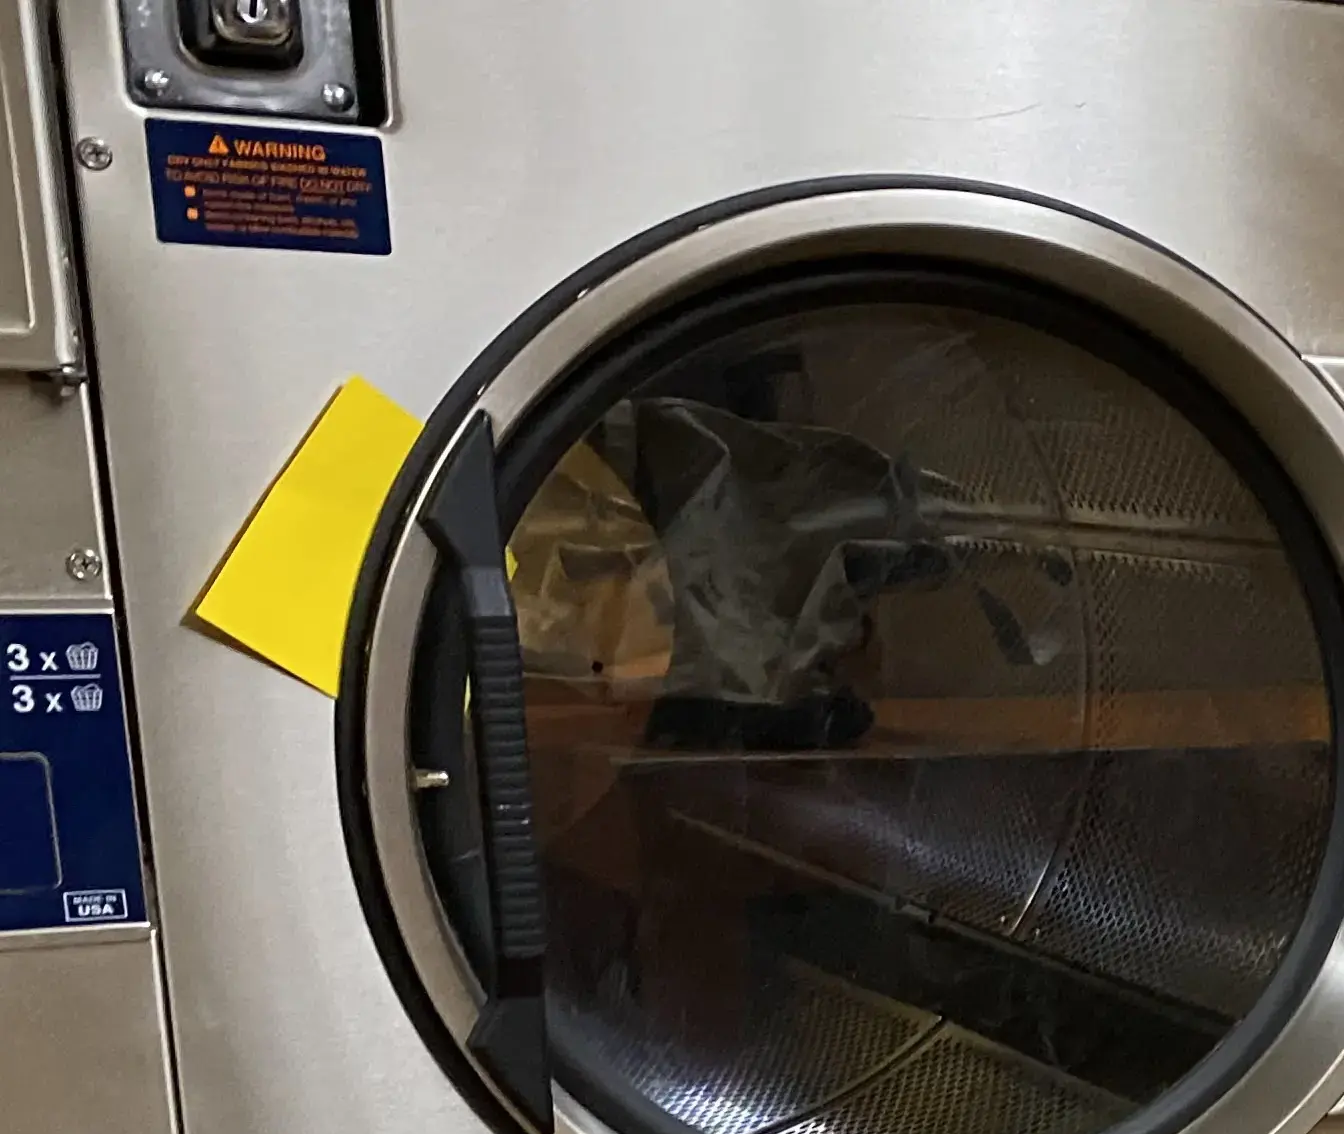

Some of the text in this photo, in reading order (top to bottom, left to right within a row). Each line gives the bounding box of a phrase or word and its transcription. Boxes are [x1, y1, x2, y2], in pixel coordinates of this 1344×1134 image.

[233, 139, 326, 161] WARNING
[6, 643, 59, 672] 3 x
[12, 684, 63, 713] 3 x
